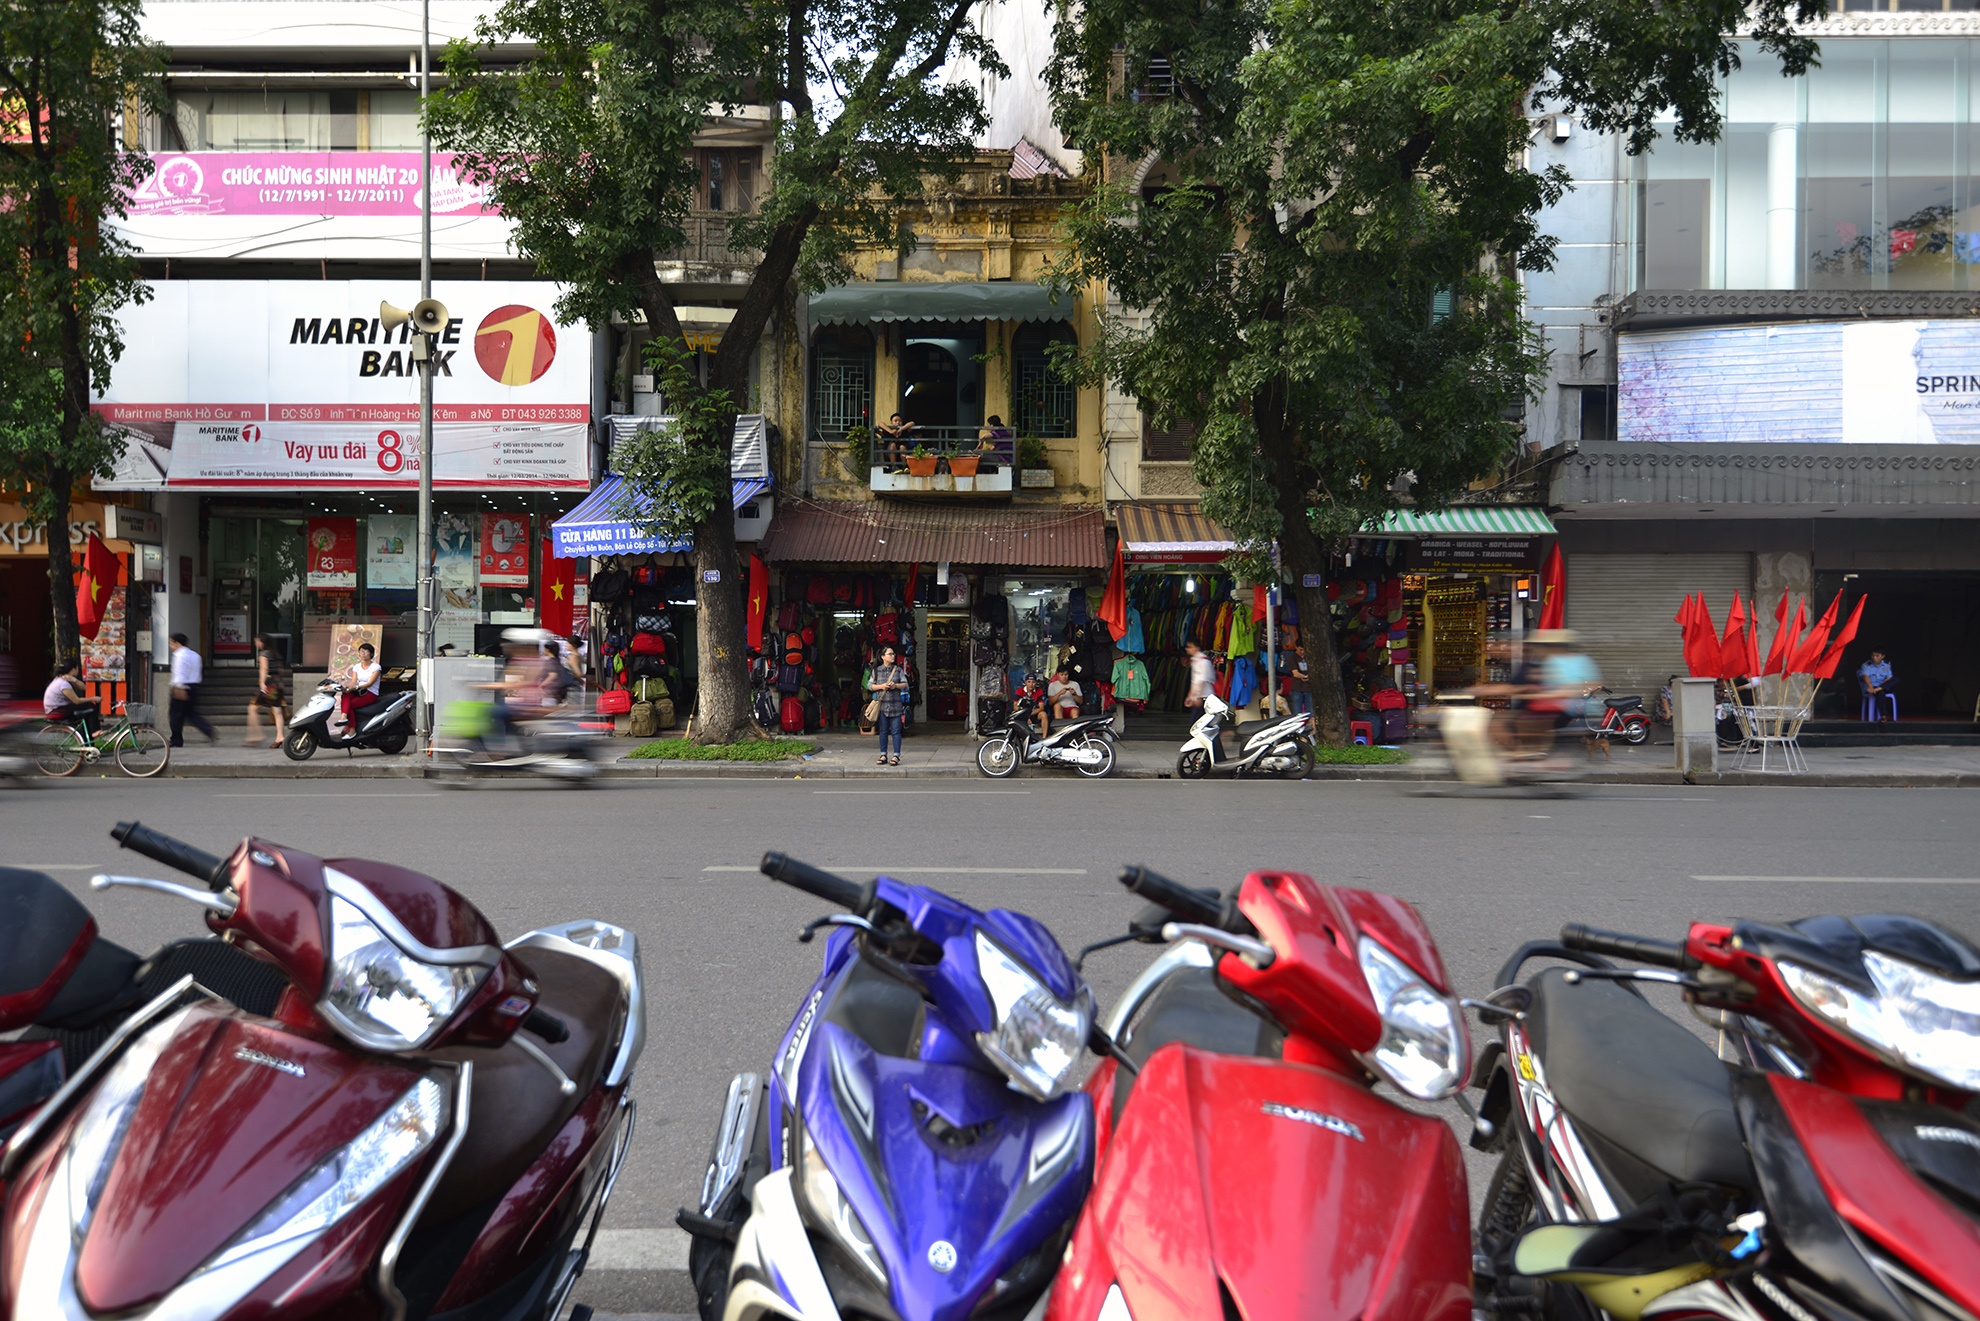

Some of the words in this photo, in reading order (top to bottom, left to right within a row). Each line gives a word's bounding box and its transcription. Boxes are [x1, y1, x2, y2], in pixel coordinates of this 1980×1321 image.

[221, 165, 262, 186] CHÚC
[264, 165, 313, 186] MỪNG
[315, 167, 352, 185] SINH
[355, 165, 397, 190] NHẬT
[398, 167, 419, 186] 20
[164, 408, 192, 419] Bank
[195, 407, 211, 419] Hồ
[368, 408, 400, 421] Hoàng
[517, 409, 536, 419] 043
[538, 409, 557, 419] 926
[558, 409, 582, 419] 3388
[199, 427, 240, 435] MARITIME
[215, 434, 238, 442] BANK
[285, 441, 314, 463] Vay
[343, 442, 366, 460] đãi
[121, 515, 145, 526] MARITIME
[130, 523, 144, 532] BANK
[560, 528, 581, 544] CỬA
[583, 528, 613, 542] HÀNG
[615, 528, 627, 540] 11
[234, 1046, 307, 1078] HONDA
[1260, 1098, 1366, 1143] HONDA
